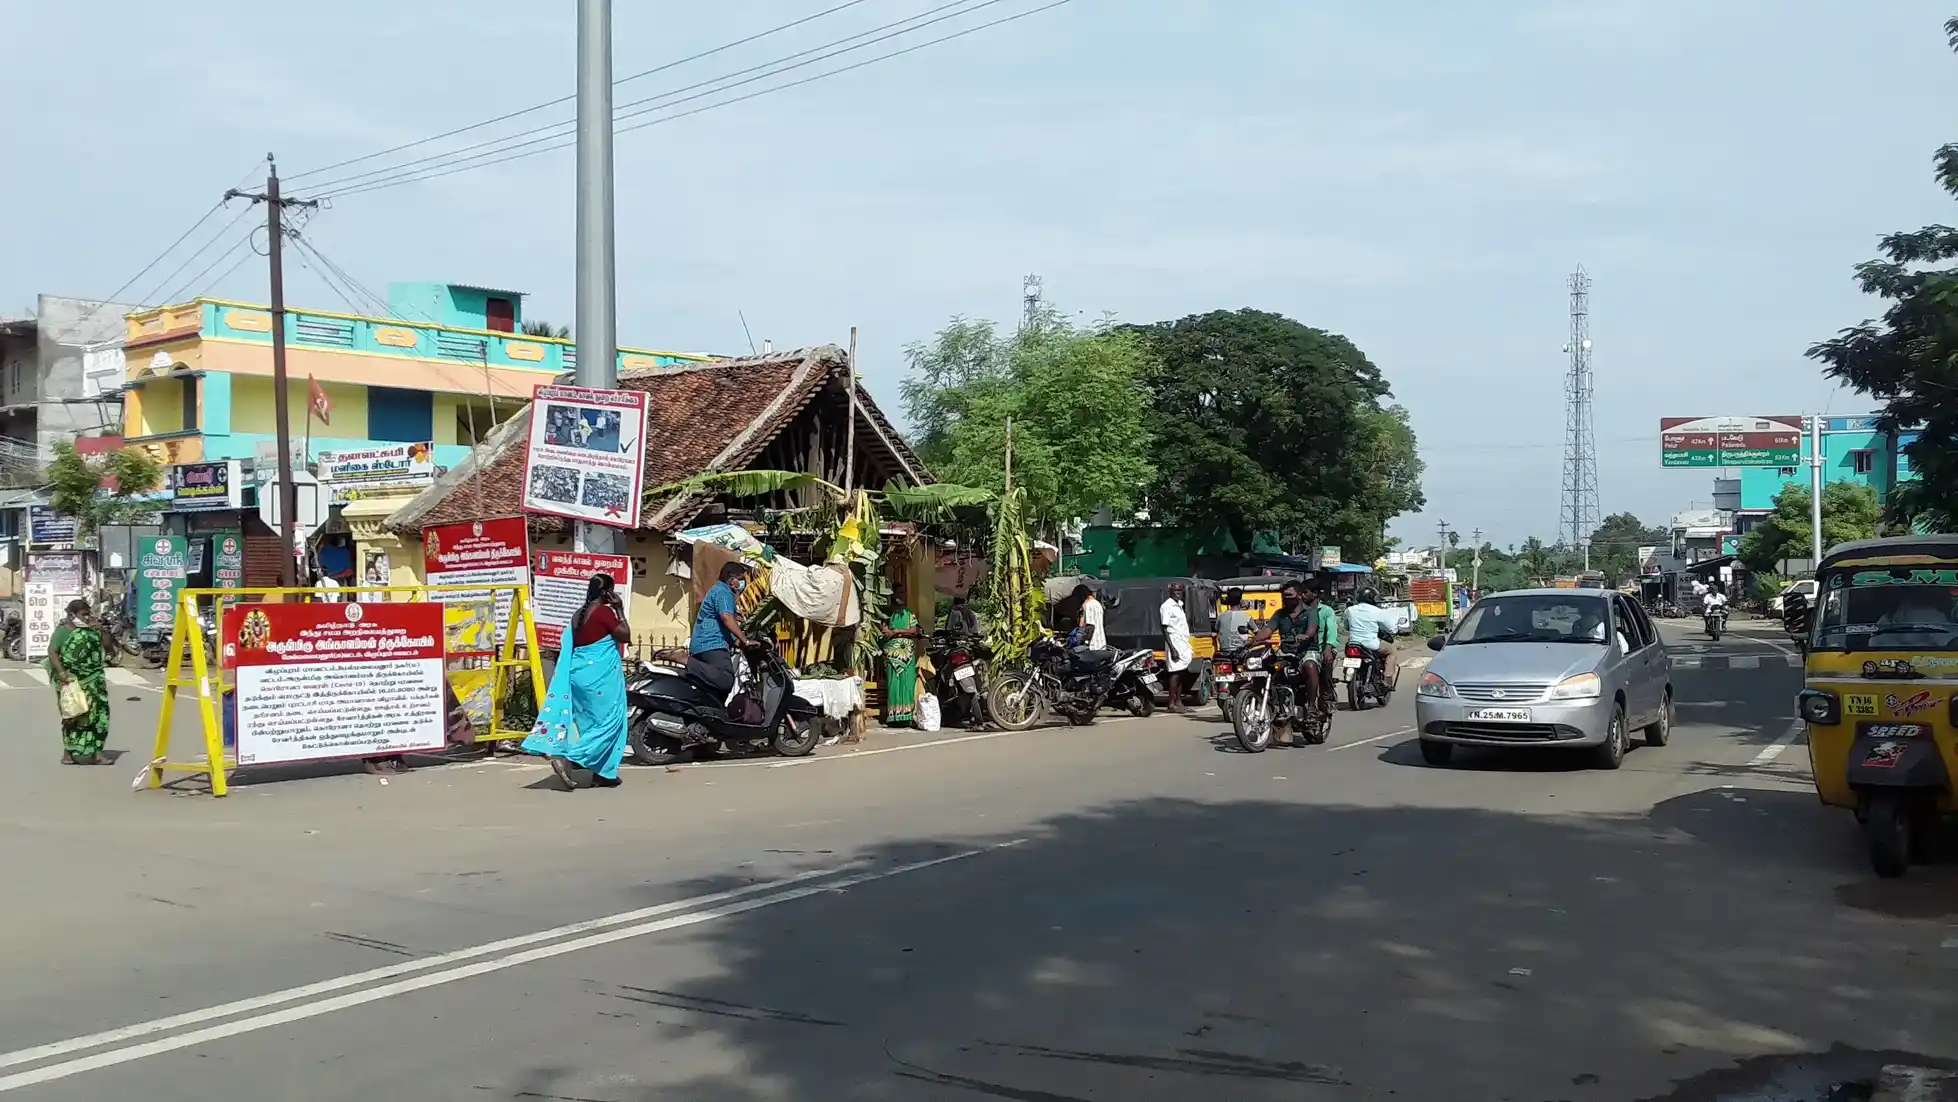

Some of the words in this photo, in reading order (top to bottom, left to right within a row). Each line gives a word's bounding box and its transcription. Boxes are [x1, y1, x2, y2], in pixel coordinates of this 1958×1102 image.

[338, 447, 404, 463] தனலட்சுமி
[330, 462, 368, 473] மளிகை
[573, 556, 592, 566] காவல்
[553, 566, 580, 577] முக்கிய
[315, 636, 377, 651] அங்காளம்மன்
[1866, 724, 1922, 738] SPEED
